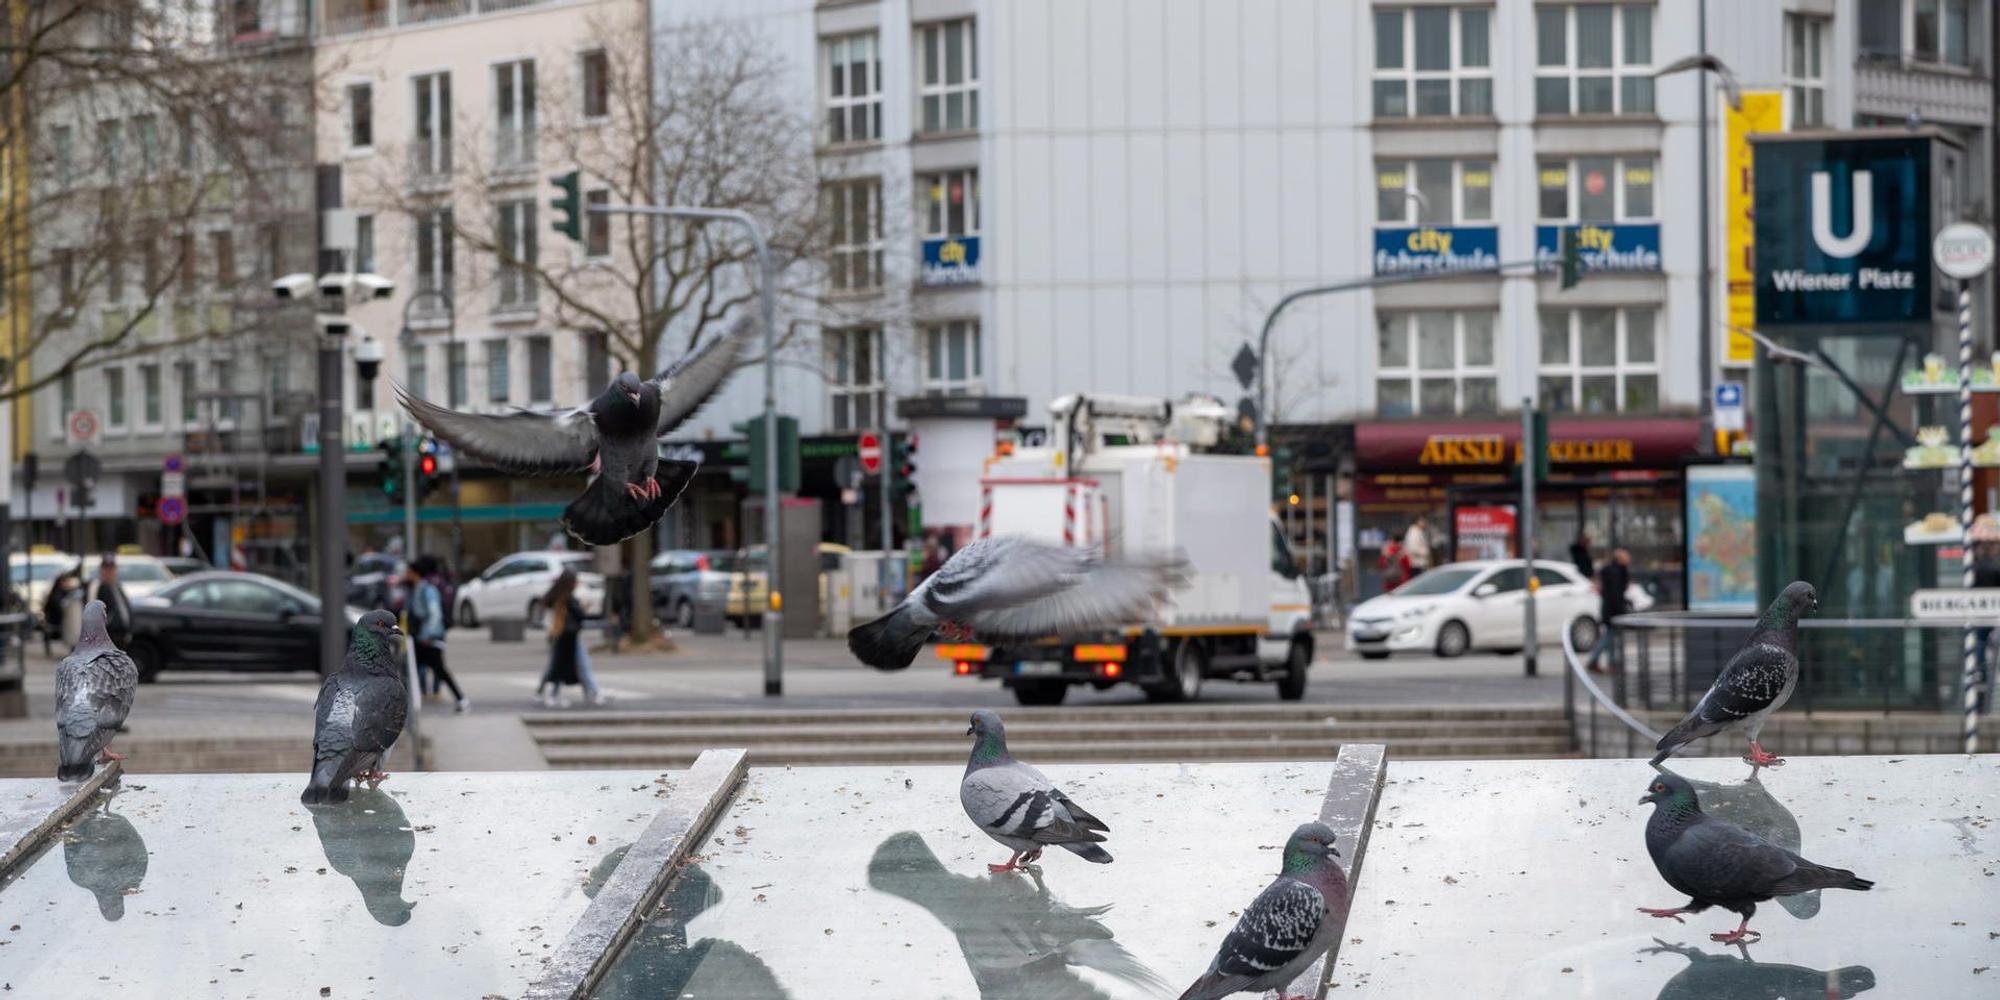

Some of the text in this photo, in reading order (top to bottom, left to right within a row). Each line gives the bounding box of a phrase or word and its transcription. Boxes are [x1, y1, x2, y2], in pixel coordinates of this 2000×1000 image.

[1811, 169, 1873, 259] U
[1407, 227, 1453, 257] city
[1376, 247, 1497, 273] fahrschule
[1772, 269, 1851, 292] Wiener
[1858, 267, 1915, 290] Platz
[1419, 434, 1504, 465] AKSU
